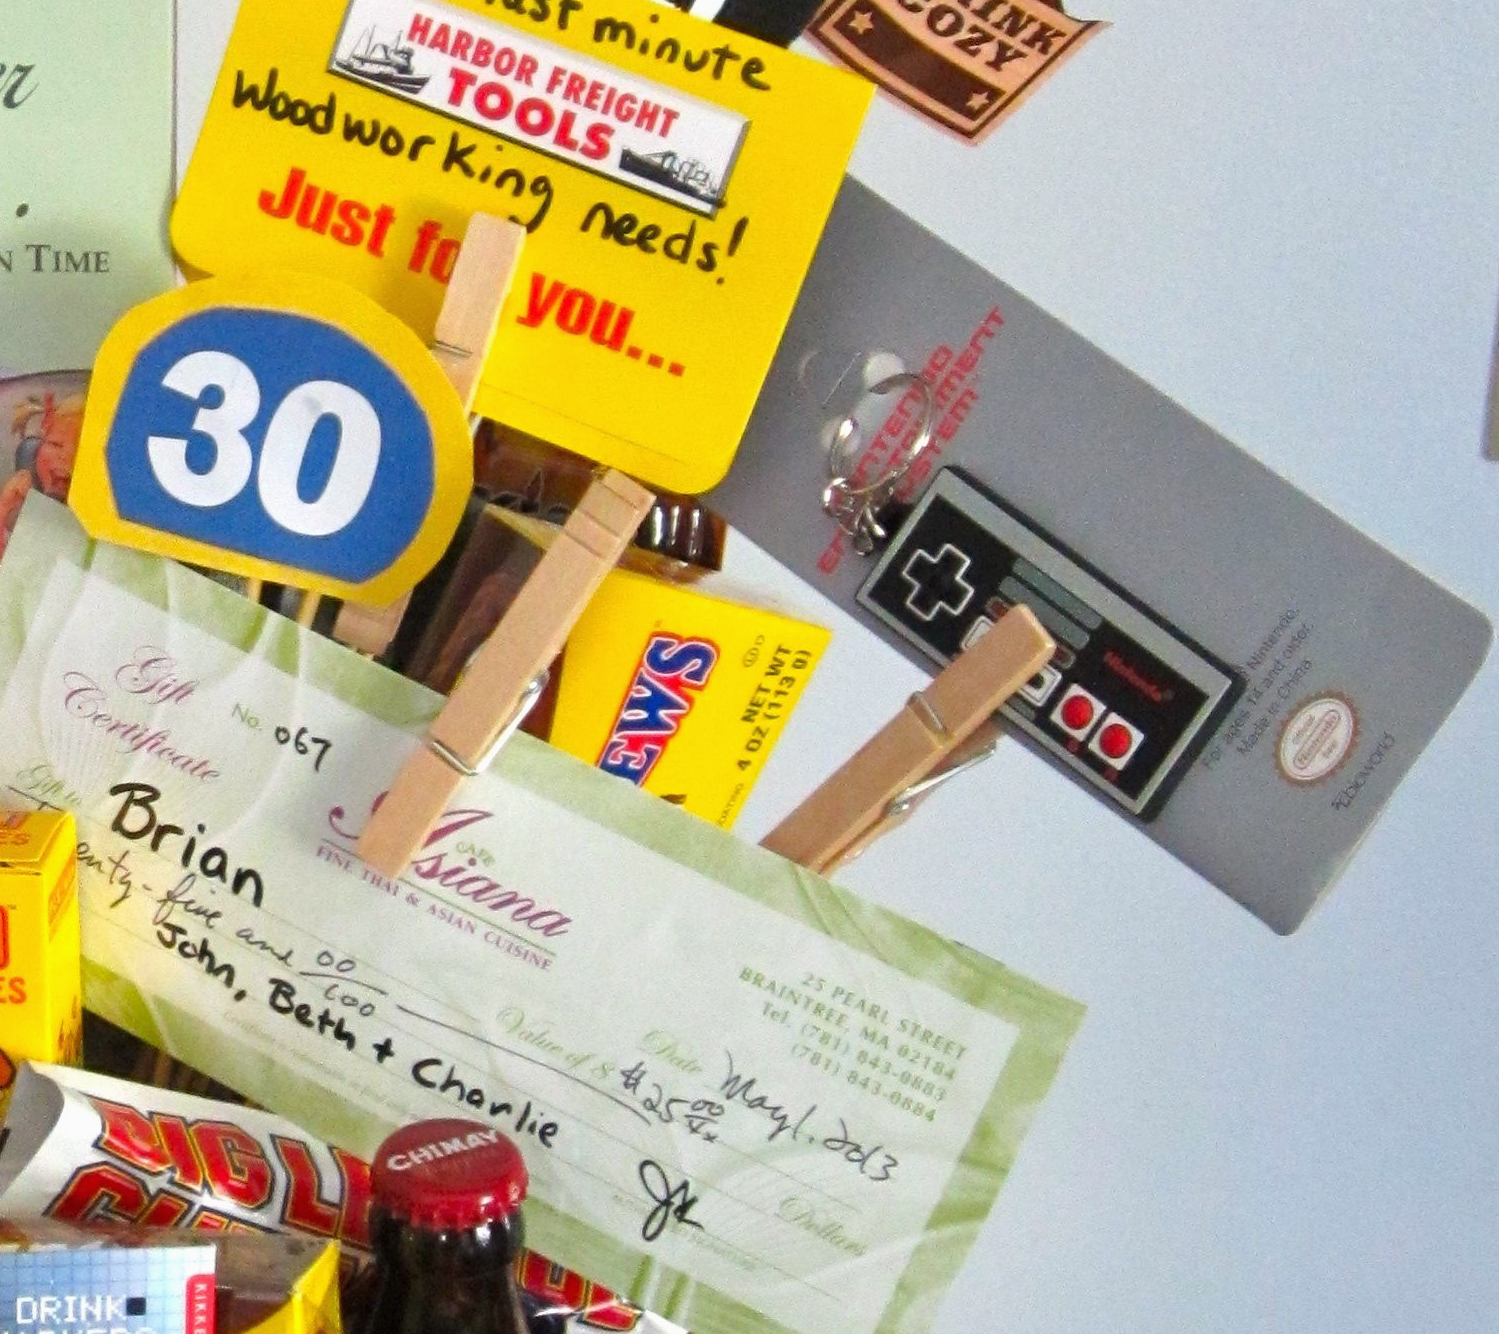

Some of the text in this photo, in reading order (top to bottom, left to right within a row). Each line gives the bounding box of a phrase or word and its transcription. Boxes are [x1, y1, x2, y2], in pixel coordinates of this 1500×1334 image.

[407, 13, 680, 139] HARBOR FREIGHT
[591, 15, 772, 91] minute
[446, 68, 613, 161] TOOLS
[258, 167, 687, 377] Just you...
[579, 201, 750, 286] needs!
[146, 348, 382, 540] 30
[116, 644, 200, 706] Gift
[740, 682, 767, 726] NET
[765, 644, 789, 680] WT
[63, 671, 220, 783] Certificate
[274, 724, 332, 773] 067
[738, 675, 795, 772] 4 OZ (113
[109, 782, 264, 907] Brian
[237, 927, 293, 967] and
[316, 844, 553, 970] FINE THAI & ASIAN CUISINE
[156, 922, 247, 1001] John,
[268, 977, 357, 1052] Beth
[411, 1057, 561, 1149] Charlie
[497, 1007, 563, 1055] Value
[800, 1019, 852, 1055] (781)
[801, 971, 969, 1061] 25 PEARL STREET
[858, 1025, 892, 1053] MA
[895, 1042, 957, 1081] 02184
[386, 1126, 499, 1173] CHIMAY
[776, 1196, 866, 1257] Dollars
[17, 1296, 127, 1325] DRINK
